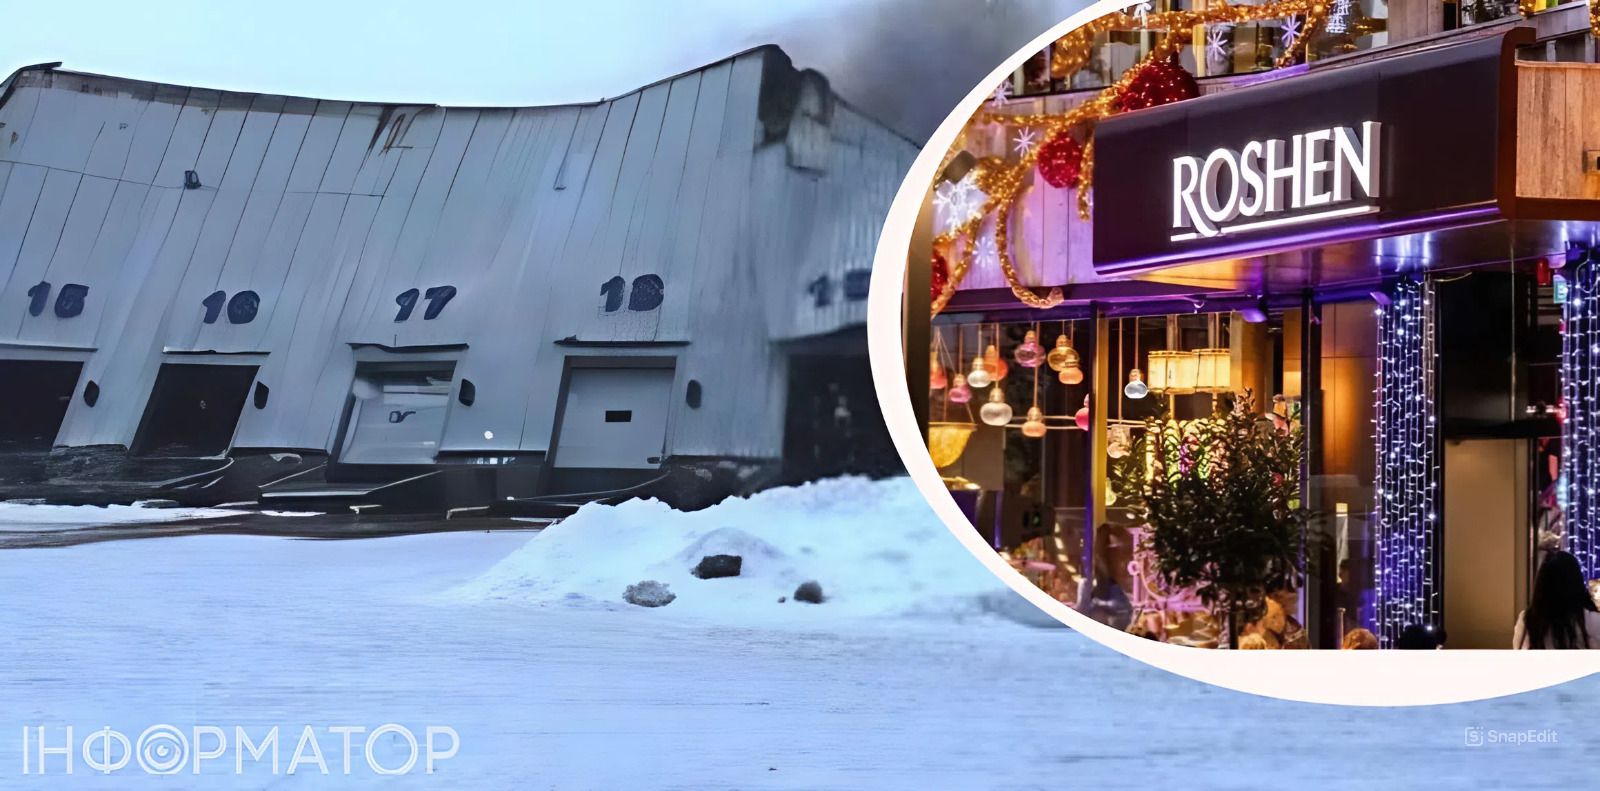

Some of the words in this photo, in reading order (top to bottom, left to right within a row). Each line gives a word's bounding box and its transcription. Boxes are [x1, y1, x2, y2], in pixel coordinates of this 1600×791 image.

[1172, 121, 1381, 237] ROSHEN
[27, 281, 90, 318] 15
[393, 285, 457, 322] 17
